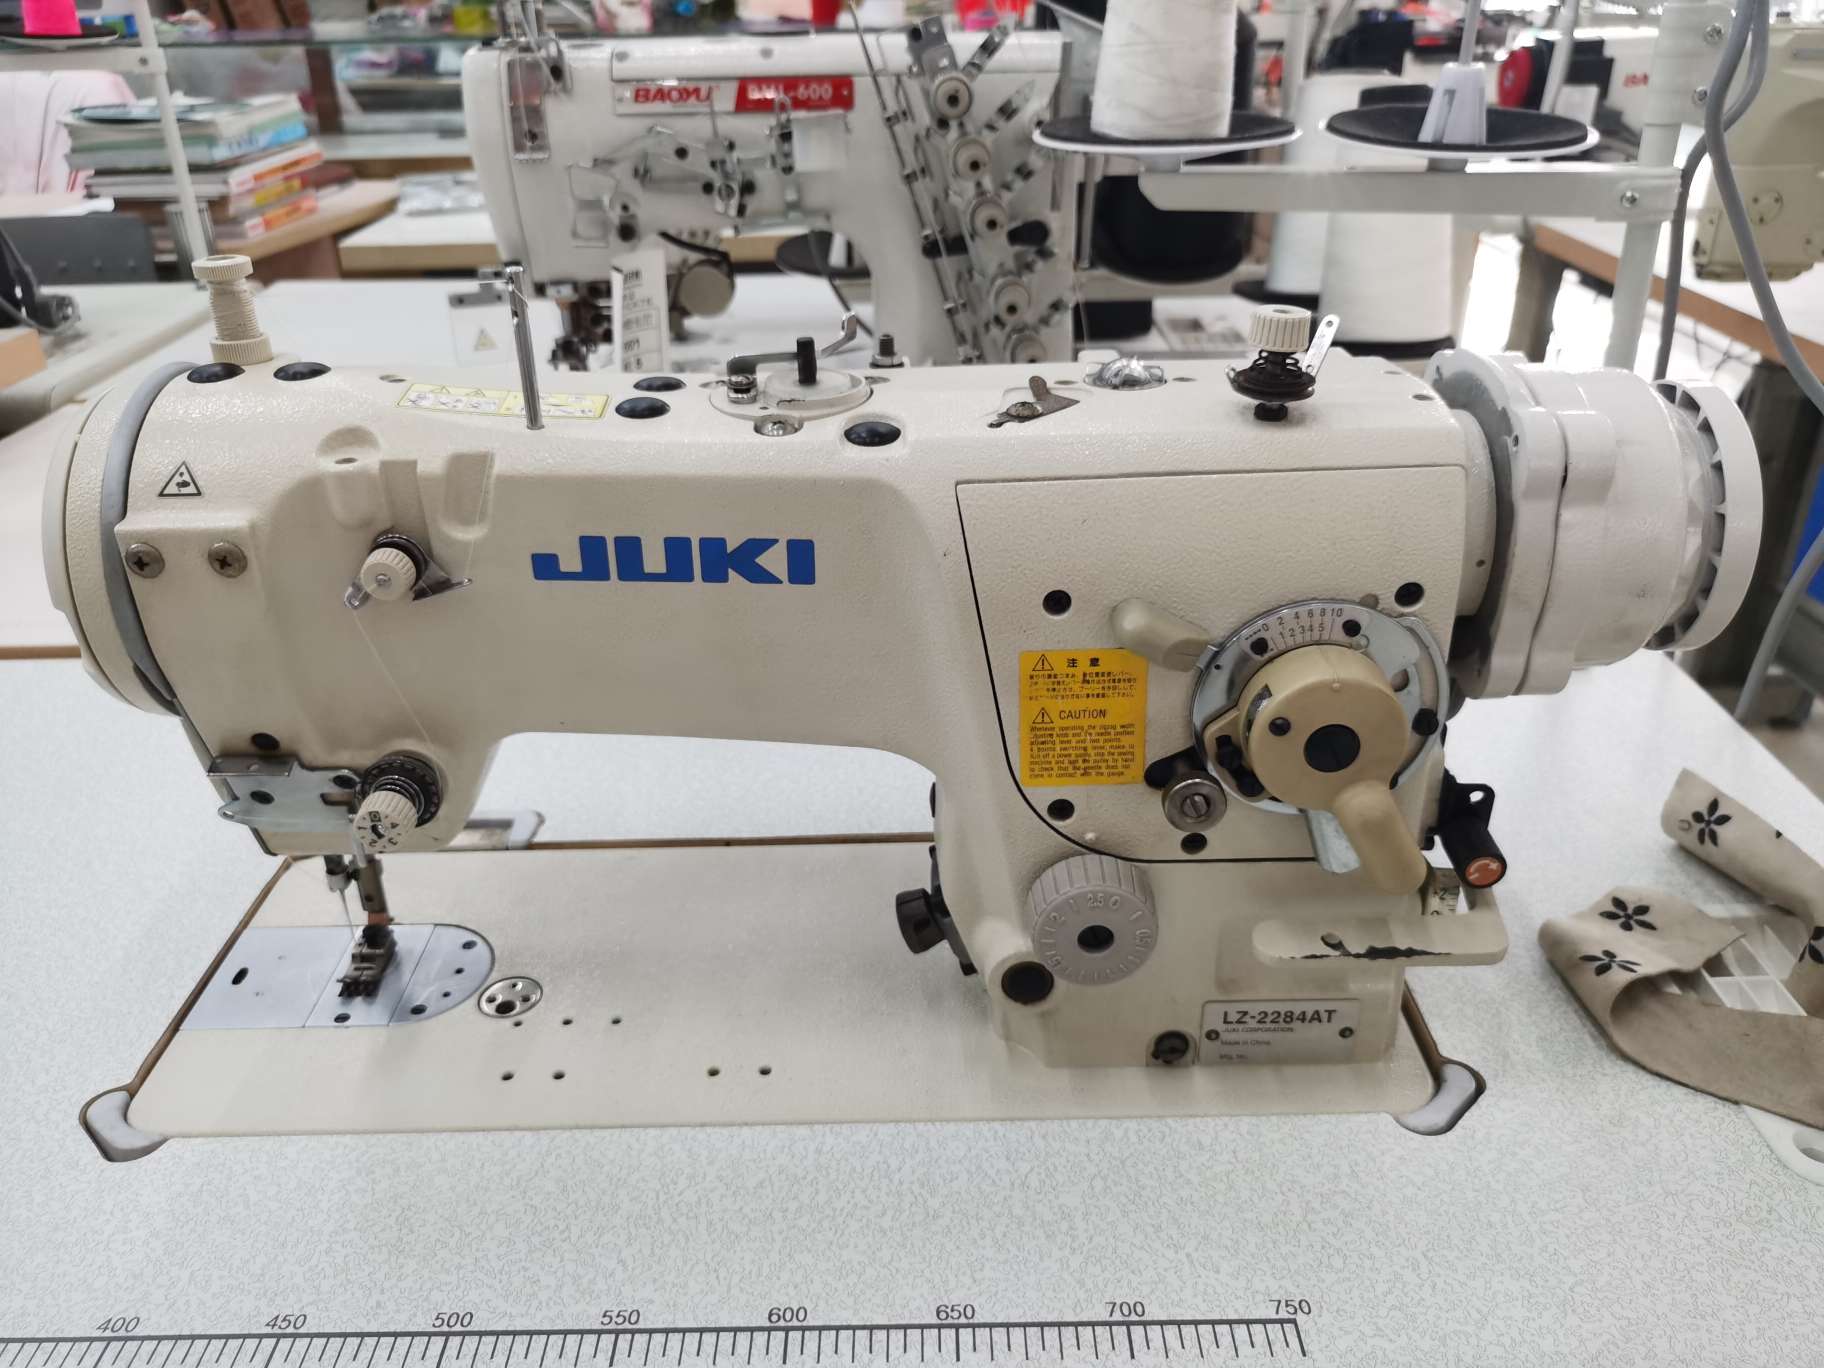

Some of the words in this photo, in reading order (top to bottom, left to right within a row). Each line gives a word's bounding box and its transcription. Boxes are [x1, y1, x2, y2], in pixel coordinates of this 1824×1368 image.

[634, 86, 711, 103] BAOYU
[531, 535, 816, 585] JUKI
[1276, 616, 1285, 626] 2
[1330, 607, 1343, 617] 10
[1299, 625, 1306, 634] 3
[1059, 709, 1106, 720] CAUTION
[1222, 1009, 1337, 1025] LZ-2284AT
[95, 1316, 140, 1334] 400
[264, 1313, 308, 1331] 450
[431, 1311, 474, 1329] 500
[600, 1309, 641, 1326] 550
[766, 1306, 808, 1324] 600
[935, 1303, 976, 1321] 650
[1104, 1301, 1146, 1318] 700
[1268, 1299, 1312, 1316] 750
